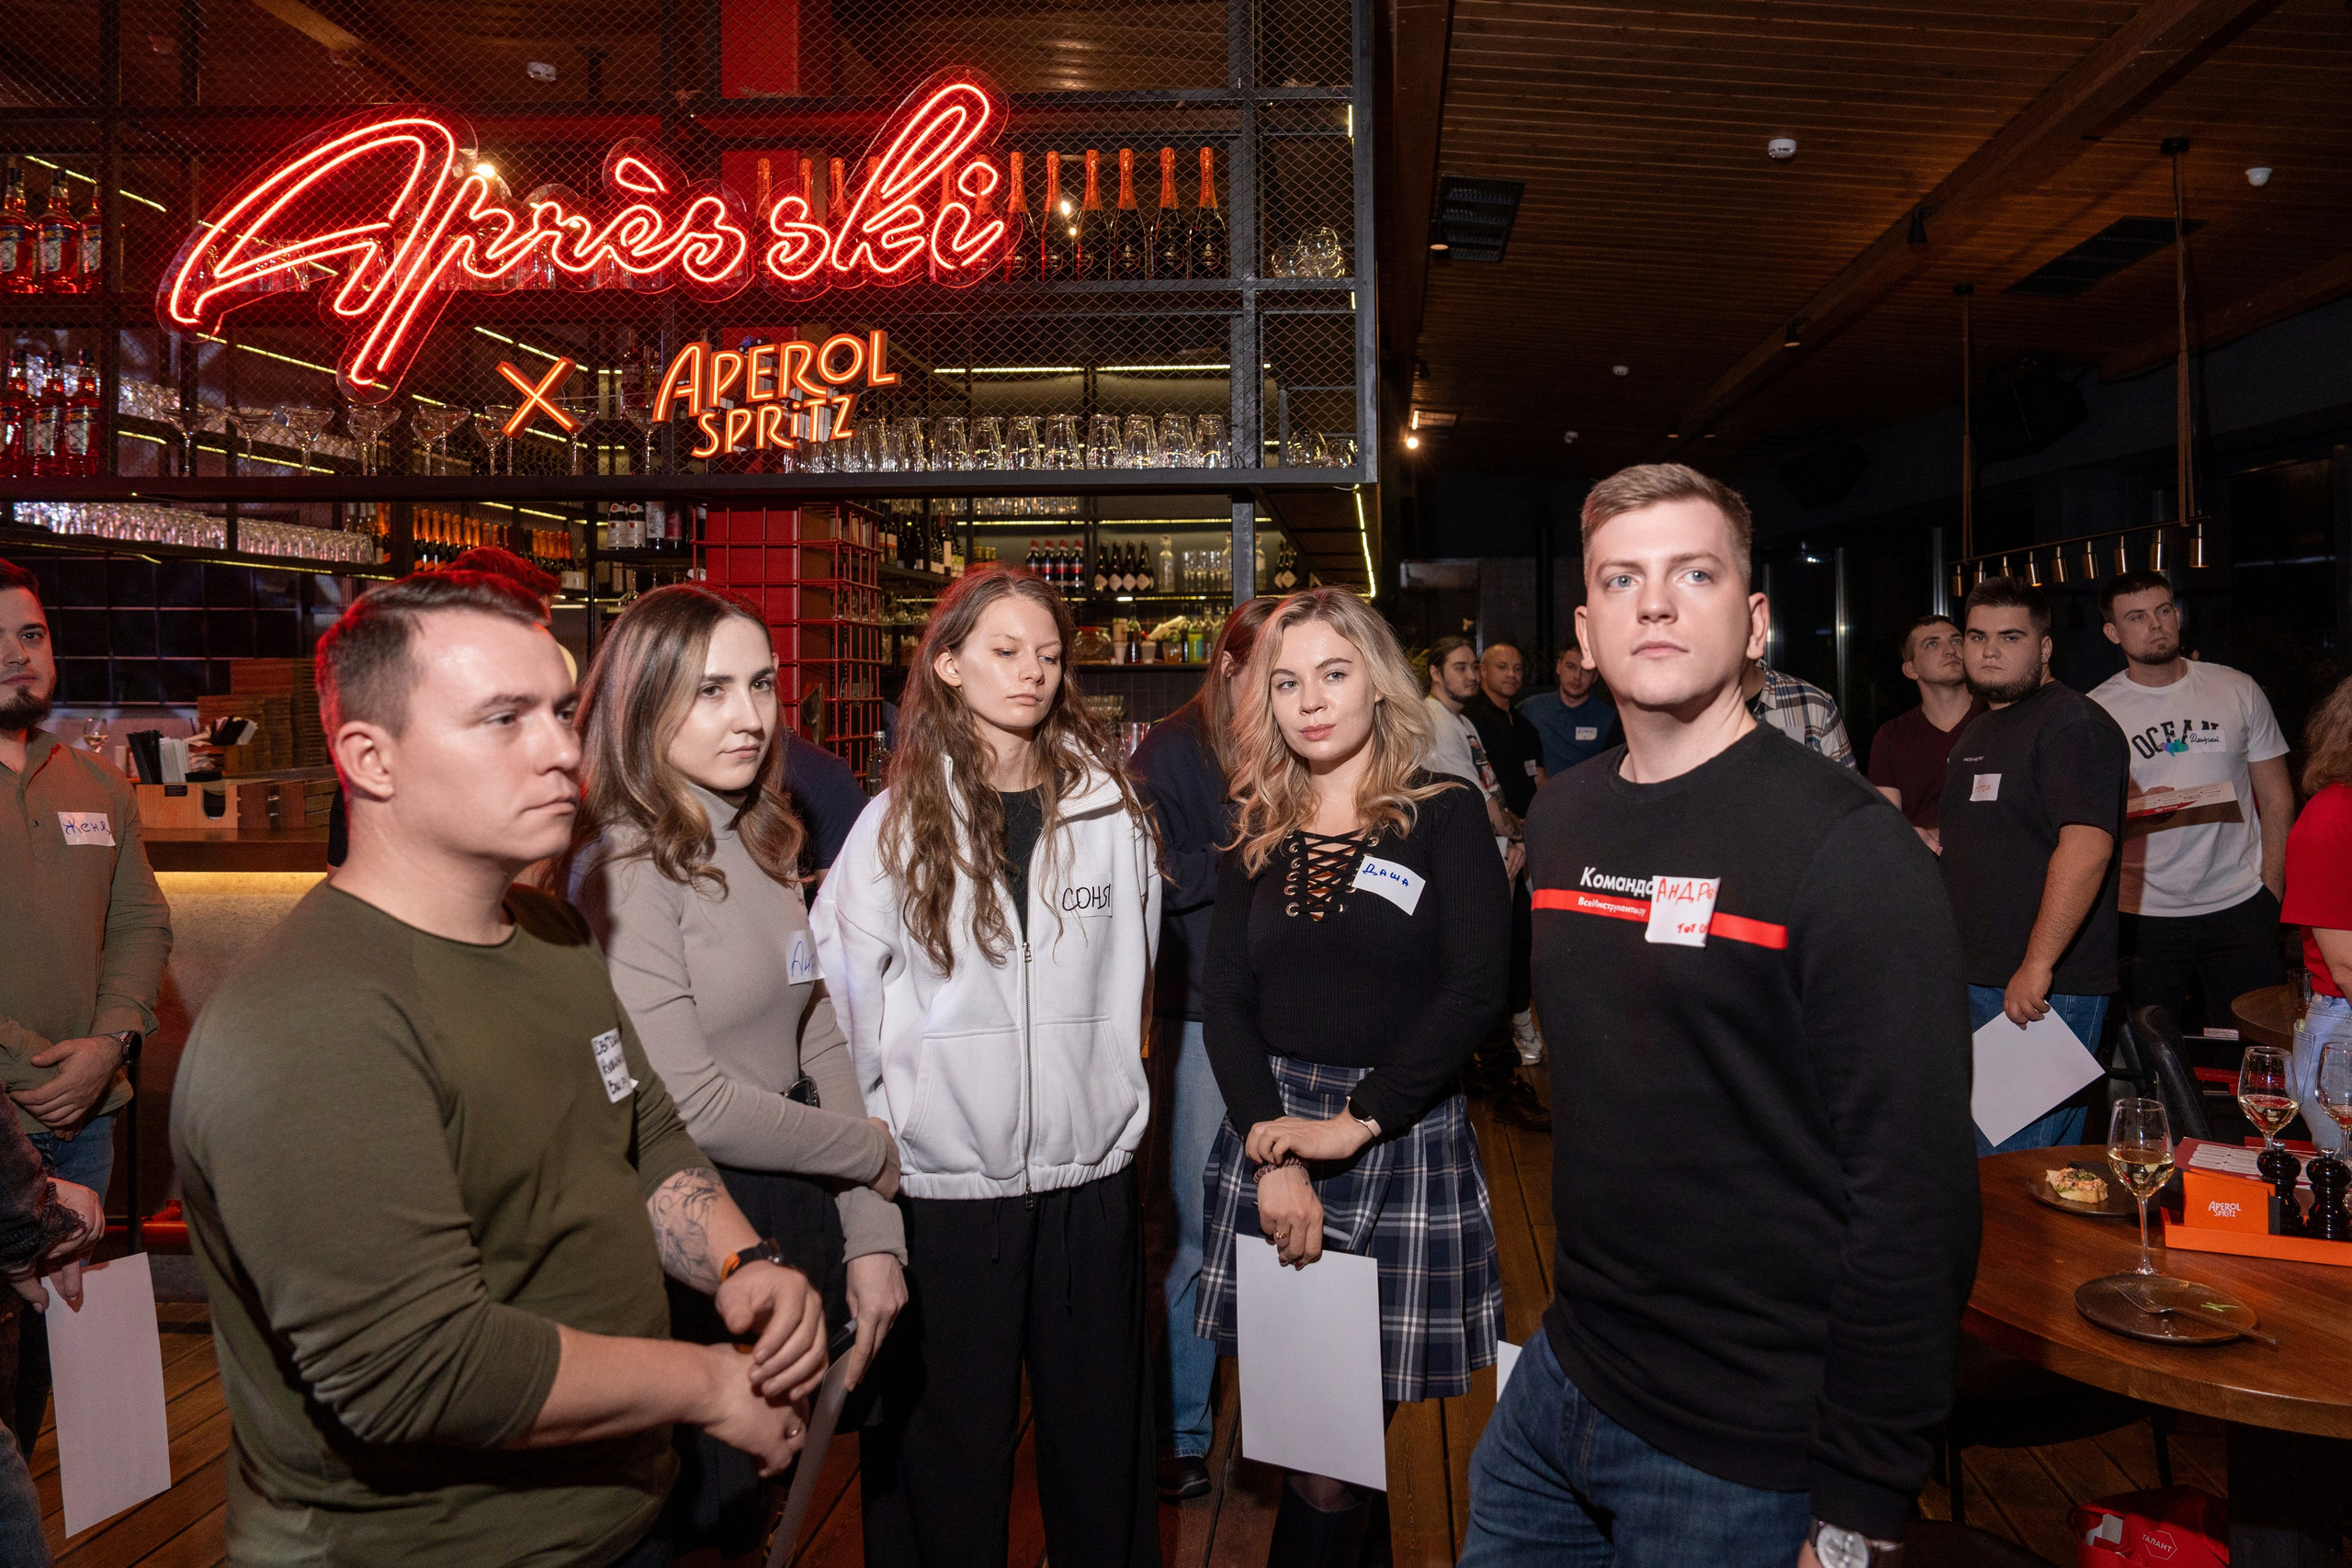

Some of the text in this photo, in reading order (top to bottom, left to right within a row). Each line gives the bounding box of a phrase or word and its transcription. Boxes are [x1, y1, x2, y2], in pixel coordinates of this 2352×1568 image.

[766, 82, 1006, 281] ski
[652, 330, 901, 424] APEROL
[1061, 883, 1112, 912] СОНЯ
[2208, 1201, 2242, 1212] APEROL
[2142, 1533, 2173, 1553] ТАЛАНТ
